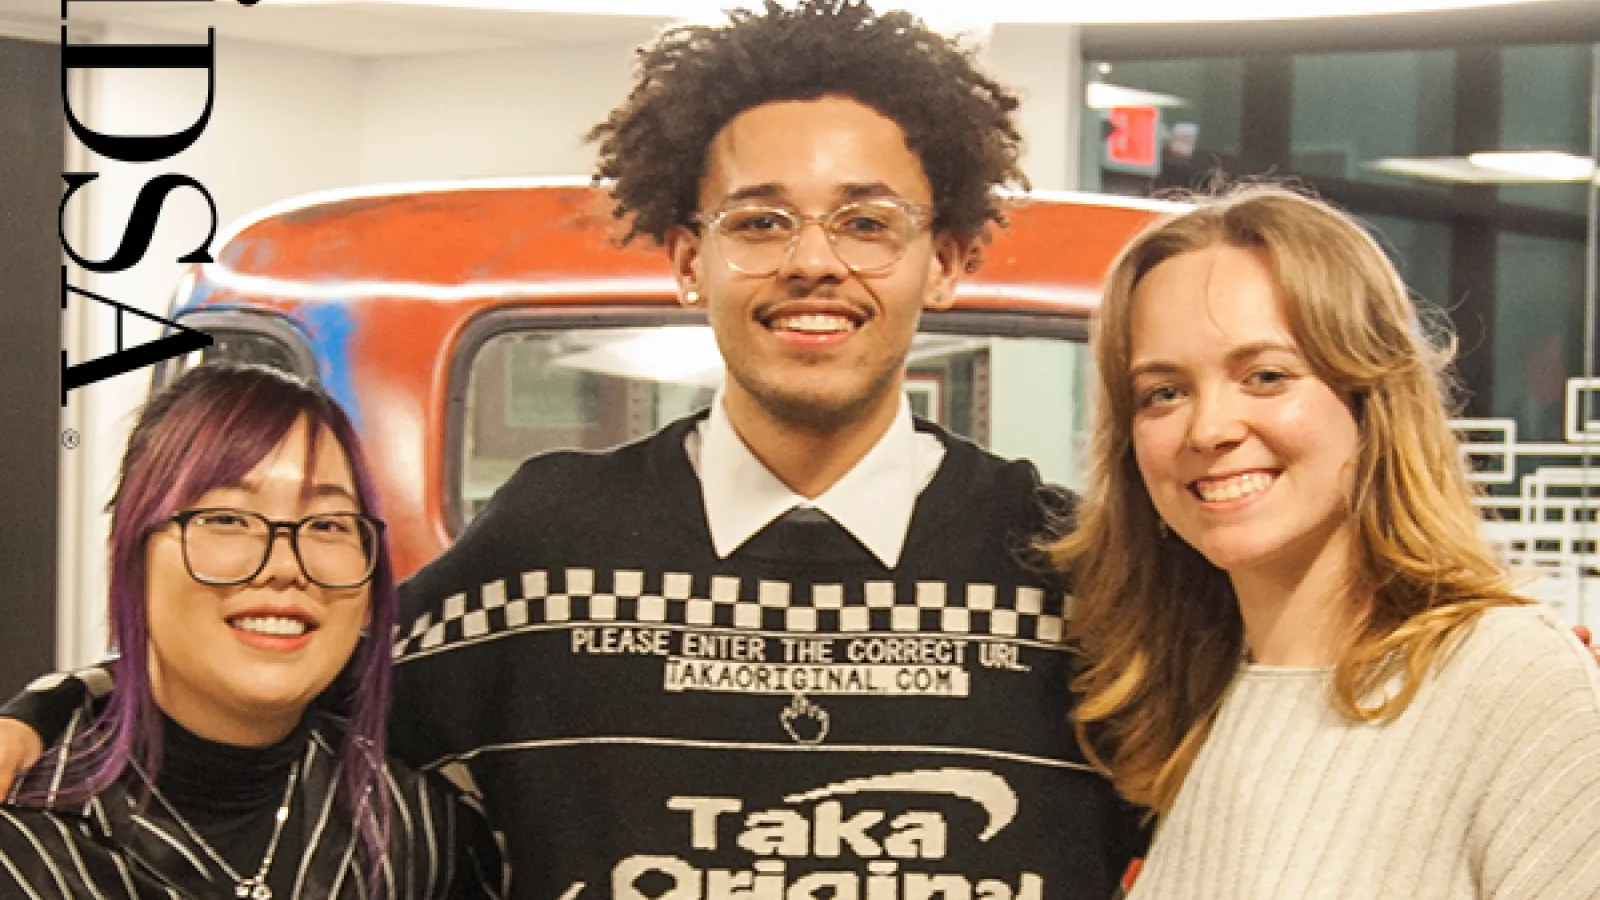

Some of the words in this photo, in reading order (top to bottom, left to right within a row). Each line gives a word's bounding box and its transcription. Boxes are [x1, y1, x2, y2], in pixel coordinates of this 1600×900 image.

[571, 628, 670, 656] PLEASE
[682, 632, 767, 662] ENTER
[781, 636, 834, 664] THE
[847, 638, 967, 664] CORRECT
[666, 796, 947, 859] Taka
